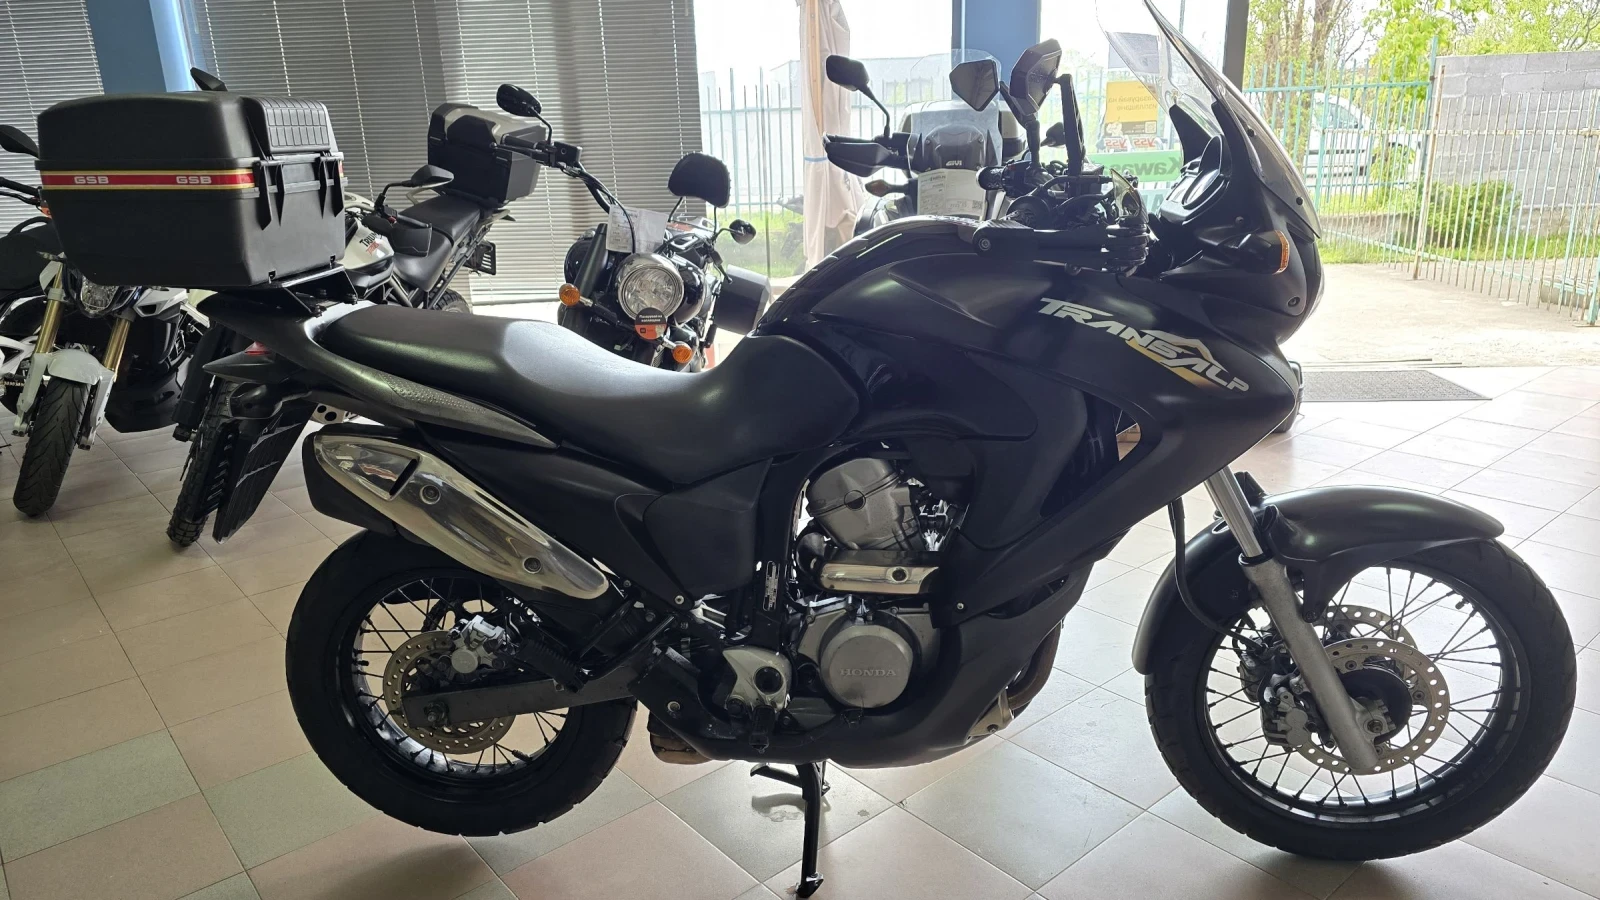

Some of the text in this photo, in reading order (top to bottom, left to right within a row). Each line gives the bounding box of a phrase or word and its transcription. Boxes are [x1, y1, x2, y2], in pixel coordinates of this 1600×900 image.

[74, 176, 212, 184] GSB GSB
[1038, 297, 1249, 392] TRANSALP
[840, 668, 896, 677] HONDA
